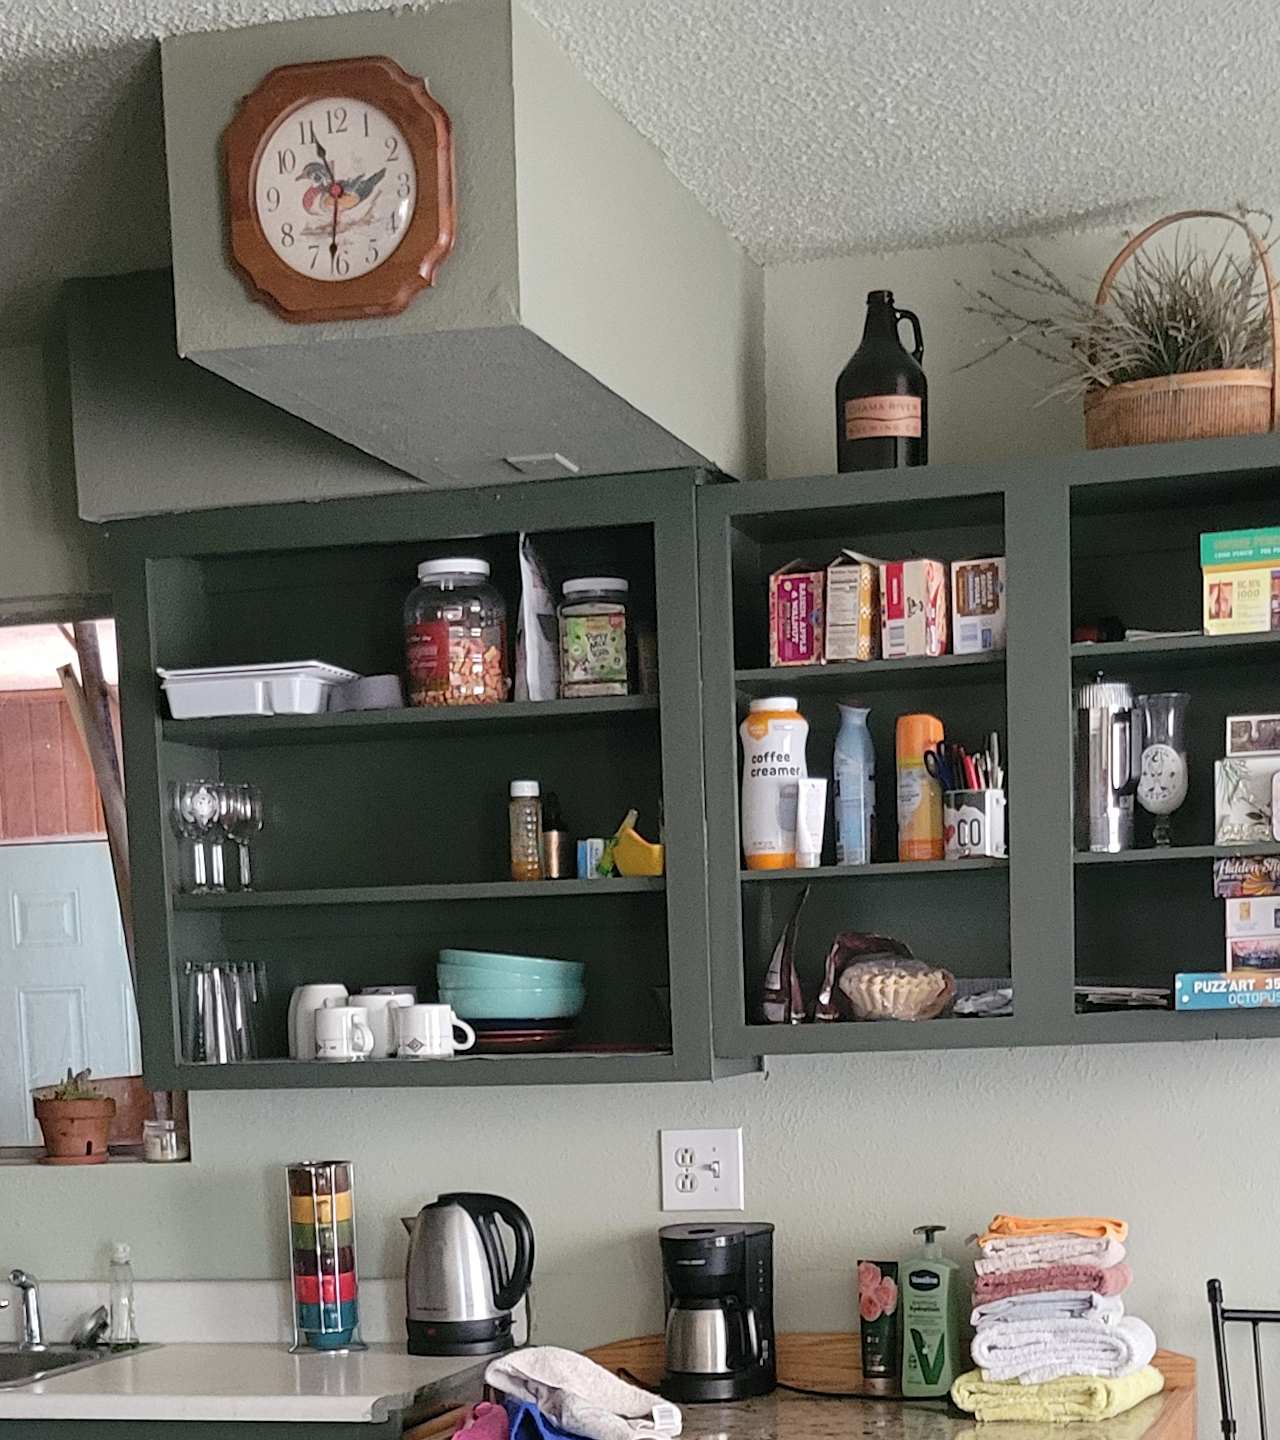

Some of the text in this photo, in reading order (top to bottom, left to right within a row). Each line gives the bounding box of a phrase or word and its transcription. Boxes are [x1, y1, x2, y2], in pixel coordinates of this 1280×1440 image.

[299, 120, 317, 145] 11
[326, 107, 348, 134] 12
[363, 111, 369, 137] 1
[277, 148, 296, 175] 10
[384, 137, 399, 162] 2
[397, 172, 410, 198] 3
[266, 187, 280, 212] 9
[386, 210, 398, 233] 4
[281, 222, 295, 247] 8
[308, 245, 320, 270] 7
[335, 251, 350, 275] 6
[365, 239, 379, 264] 5
[751, 751, 791, 764] coffee
[750, 766, 800, 778] creamer
[1216, 859, 1260, 878] Hidden
[1194, 978, 1256, 993] PUZZ'ART
